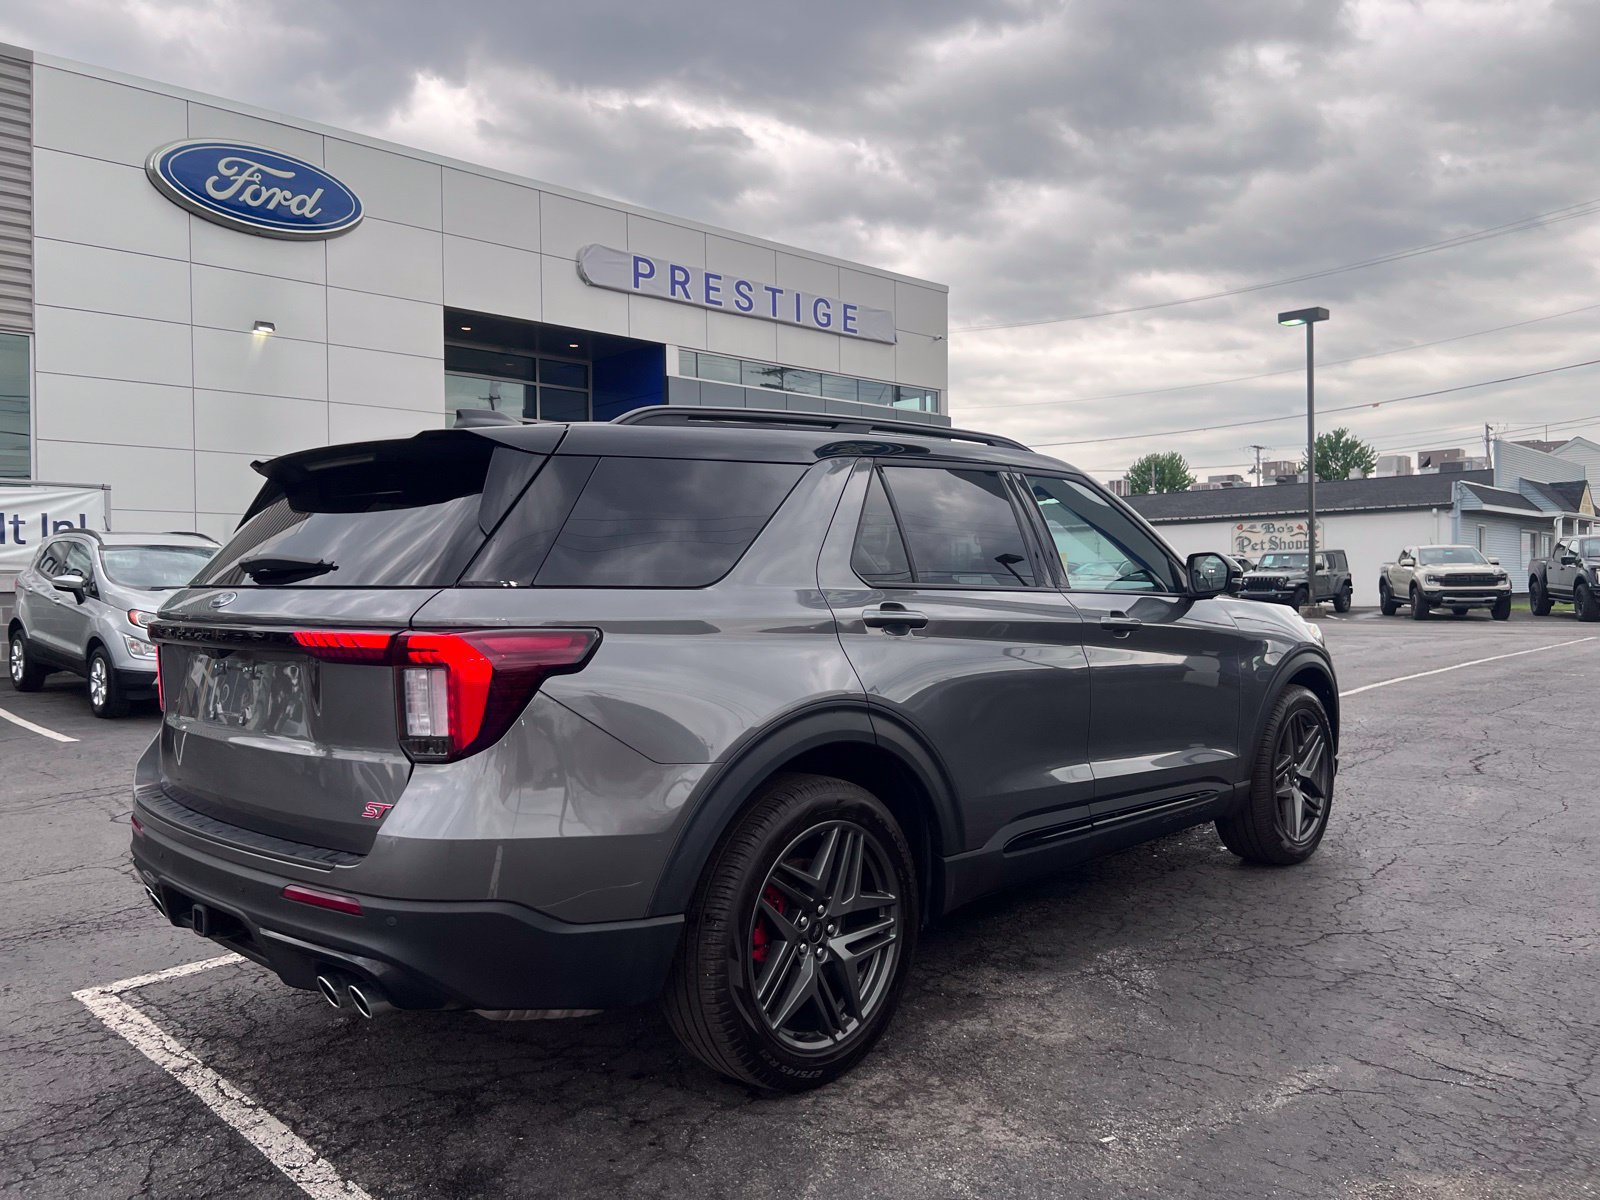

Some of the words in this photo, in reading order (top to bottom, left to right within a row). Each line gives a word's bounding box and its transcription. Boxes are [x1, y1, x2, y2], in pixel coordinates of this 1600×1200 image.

[205, 156, 324, 219] Ford
[632, 254, 858, 335] PRESTIGE
[1261, 522, 1294, 535] Bo's
[1235, 535, 1266, 553] Pet
[361, 801, 394, 819] ST
